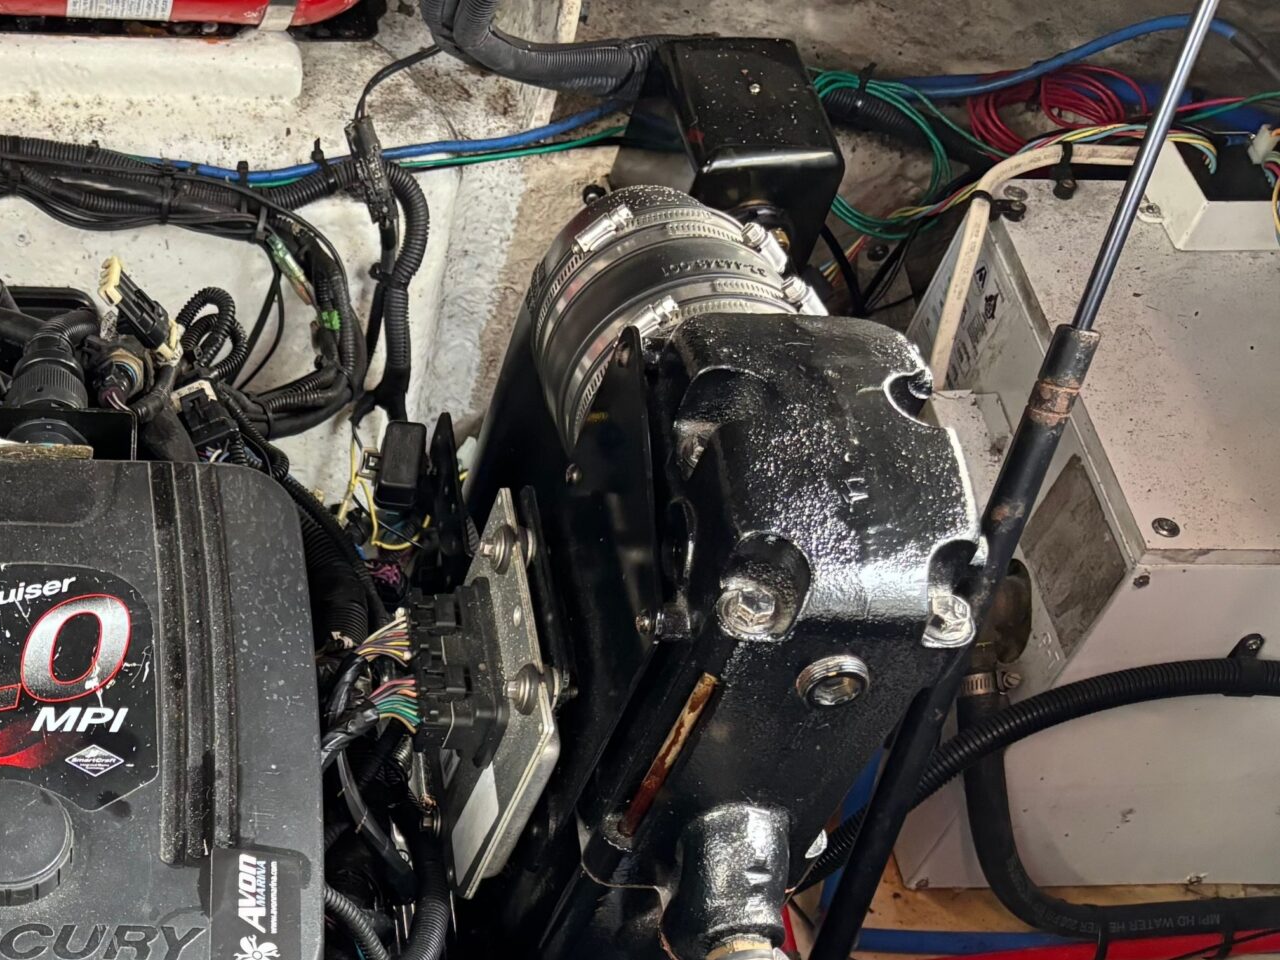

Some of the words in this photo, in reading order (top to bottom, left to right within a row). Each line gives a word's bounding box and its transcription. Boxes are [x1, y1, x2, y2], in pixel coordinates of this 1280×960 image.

[31, 707, 127, 733] MPI
[256, 860, 266, 906] MARINA
[1129, 917, 1173, 930] WATER
[1177, 915, 1194, 926] HD
